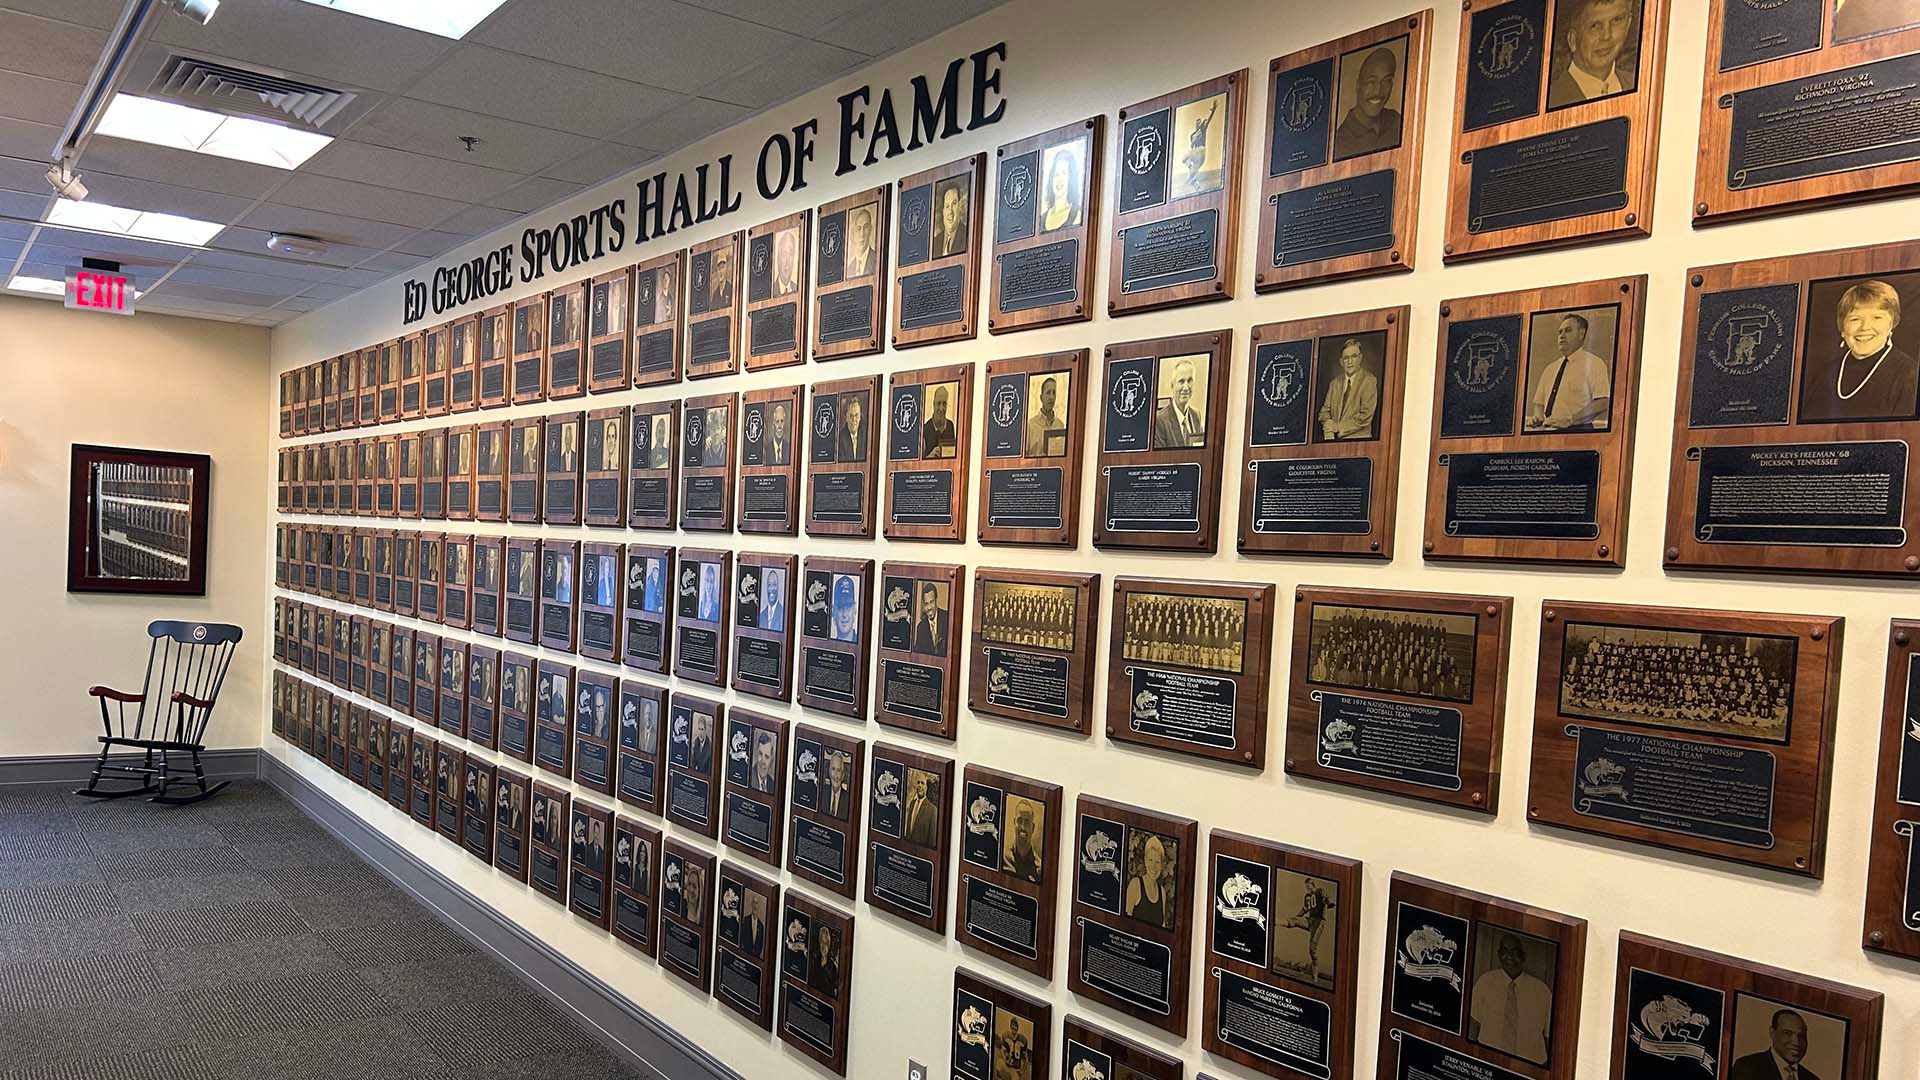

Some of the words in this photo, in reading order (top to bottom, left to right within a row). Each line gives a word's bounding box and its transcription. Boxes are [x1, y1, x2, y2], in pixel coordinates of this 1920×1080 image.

[1839, 80, 1875, 93] VIRGINIA
[402, 279, 428, 325] ED
[431, 243, 514, 315] GEORGE
[519, 199, 626, 284] SPORTS
[635, 153, 742, 245] HALL
[756, 117, 818, 201] OF
[835, 41, 1008, 177] FAME
[77, 271, 128, 311] EXIT
[1751, 452, 1779, 460] MICKEY
[1780, 451, 1799, 459] KEYS
[1799, 451, 1836, 459] FREEMAN
[1797, 458, 1839, 466] TENNESSEE
[1366, 707, 1395, 716] FOOTBALL
[1367, 701, 1395, 710] NATIONAL
[1395, 704, 1441, 716] CHAMPIONSHIP
[1607, 733, 1621, 742] THE
[1622, 734, 1641, 744] 1977
[1641, 738, 1681, 750] NATIONAL
[1681, 743, 1744, 759] CHAMPIONSHIP
[1641, 745, 1679, 757] FOOTBALL
[1680, 750, 1703, 760] TEAM
[1278, 1001, 1304, 1013] CALIFORNIA
[1441, 1060, 1471, 1076] STAUNTON,
[1460, 1060, 1483, 1074] VENABLE
